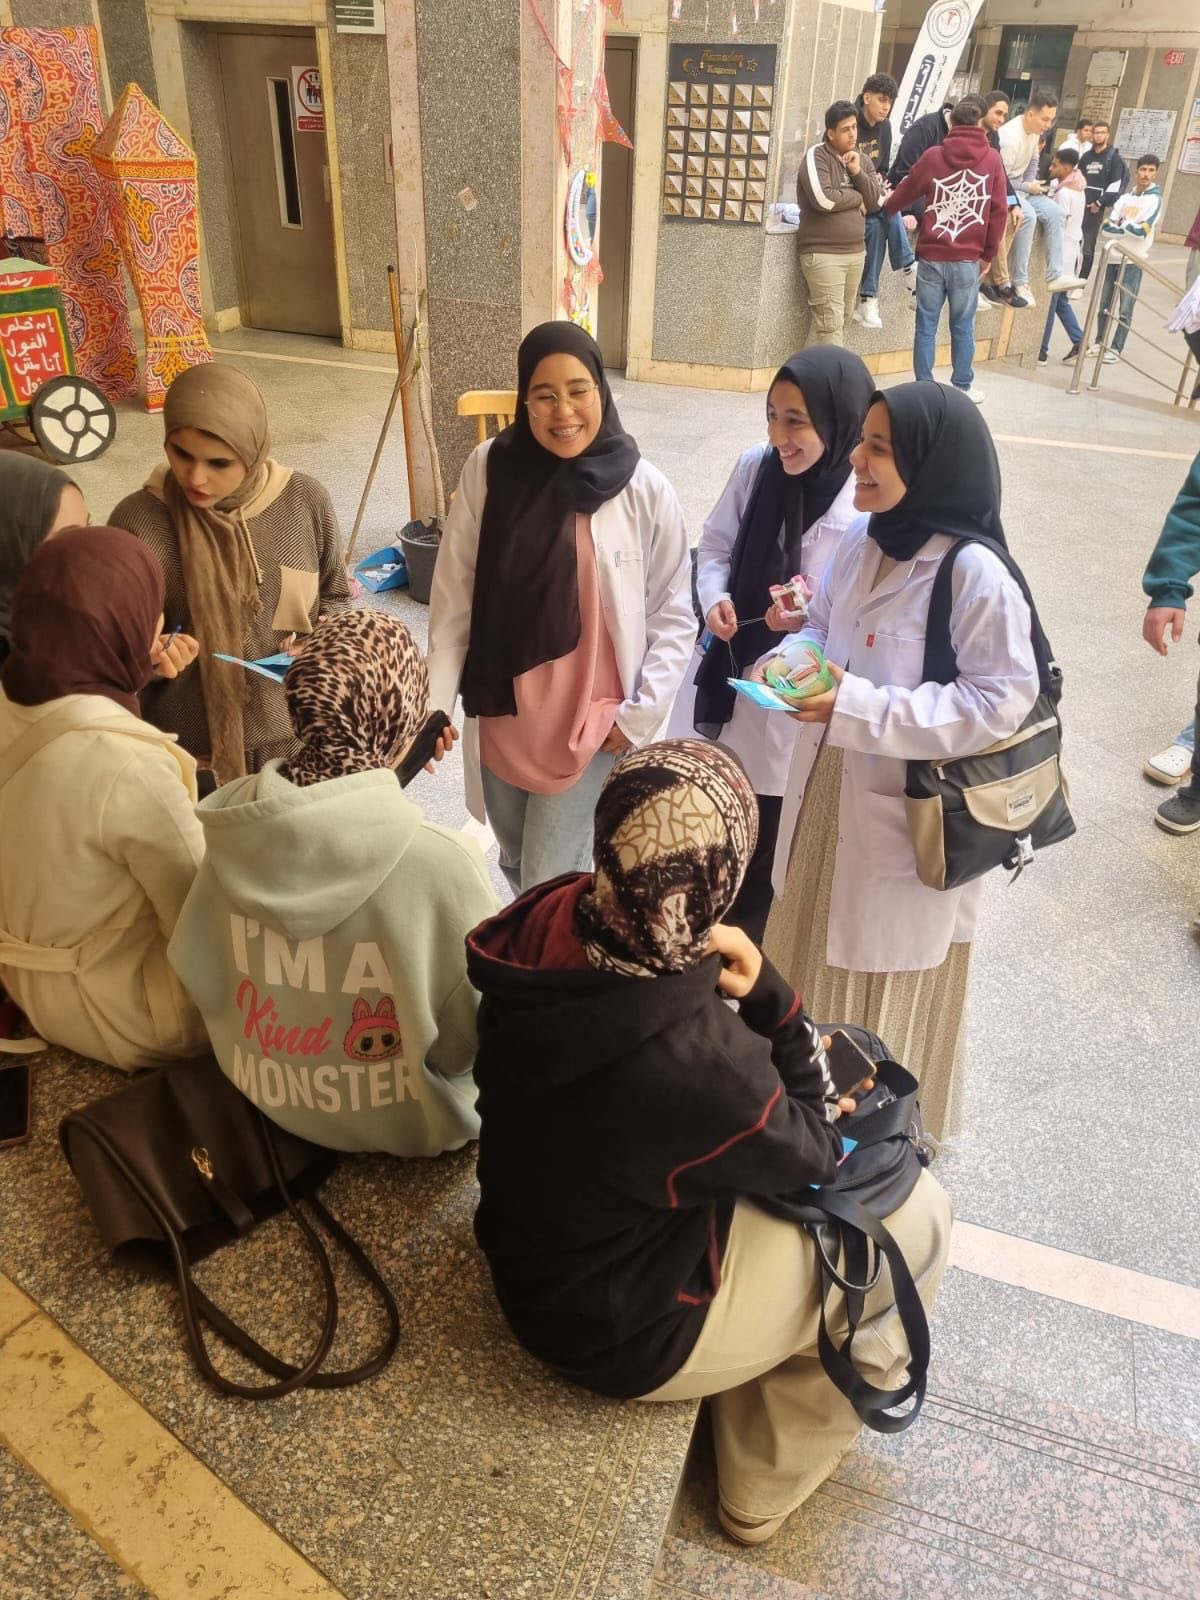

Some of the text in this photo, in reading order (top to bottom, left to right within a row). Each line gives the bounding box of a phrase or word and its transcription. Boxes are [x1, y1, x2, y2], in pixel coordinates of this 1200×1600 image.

[1170, 52, 1185, 64] EXIT
[0, 316, 33, 337] خلص
[6, 332, 47, 358] الفول
[14, 353, 40, 375] مش
[229, 913, 395, 994] I'M A
[236, 977, 334, 1057] Kind
[232, 1044, 420, 1113] MONSTER
